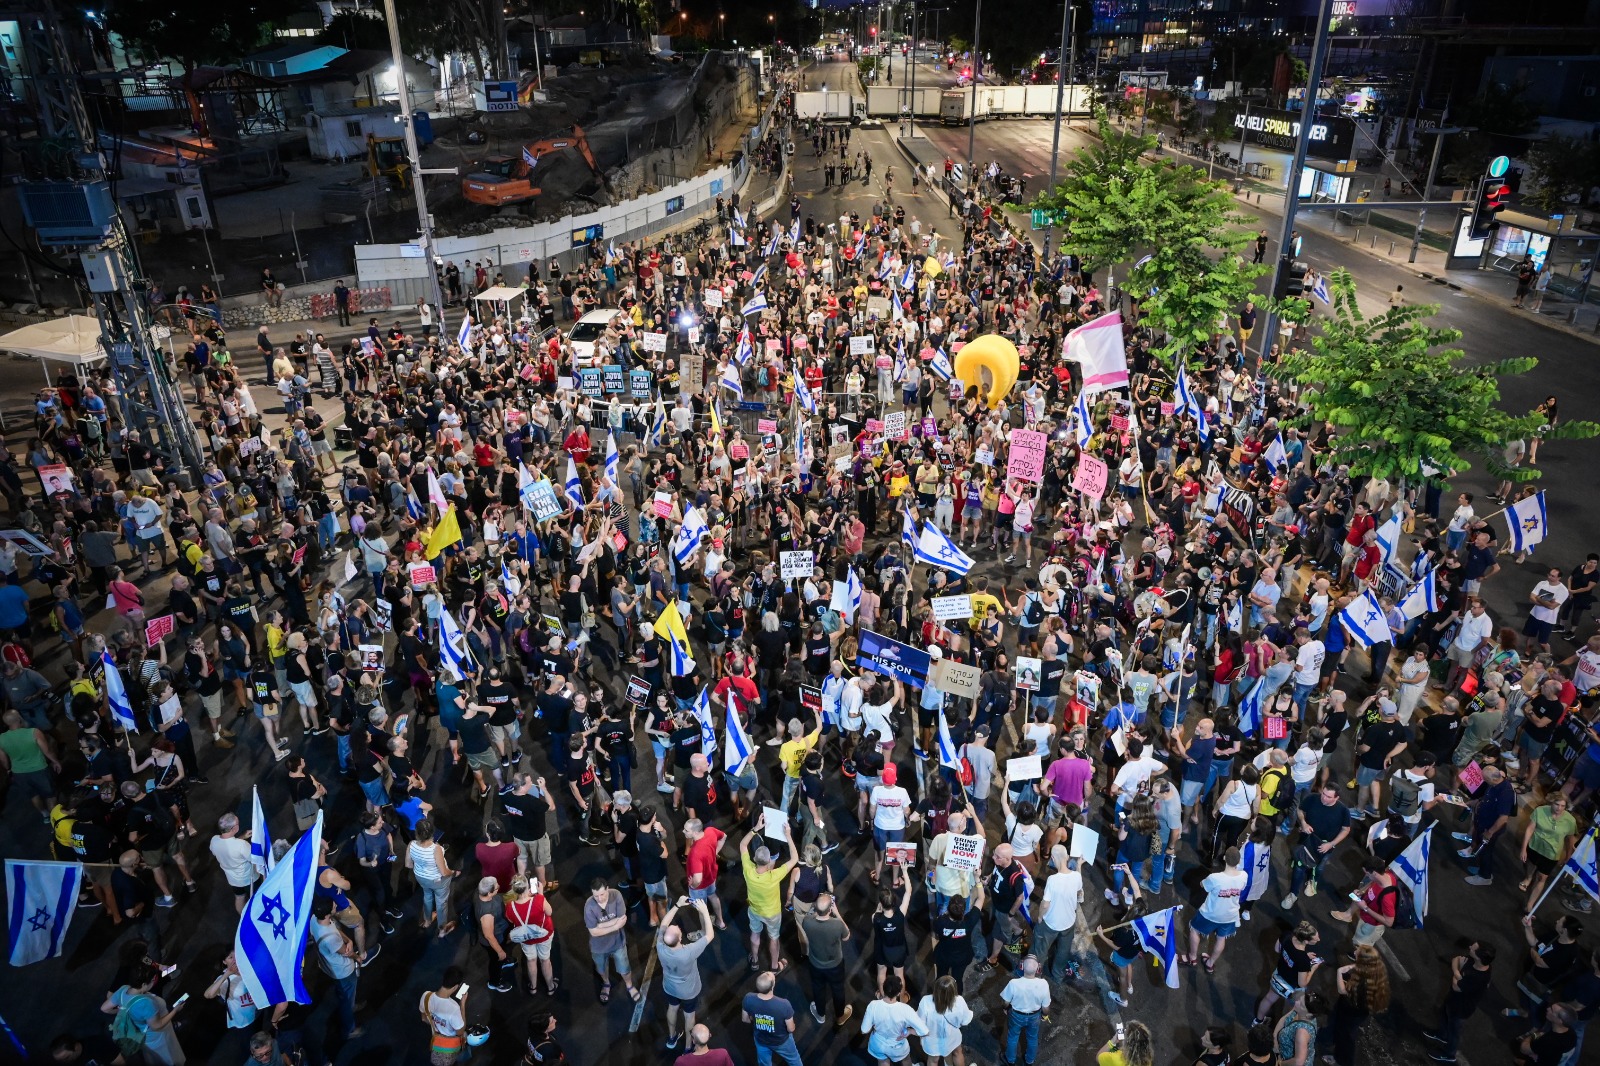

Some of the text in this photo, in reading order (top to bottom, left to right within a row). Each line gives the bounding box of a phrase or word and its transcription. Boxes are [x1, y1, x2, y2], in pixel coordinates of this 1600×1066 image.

[489, 101, 518, 111] הנדסה
[1264, 118, 1291, 136] SPIRAL
[528, 486, 550, 501] SEAL
[534, 495, 553, 509] THE
[536, 503, 560, 519] DEAL
[871, 654, 912, 676] HIS SON
[950, 668, 974, 679] עסקה
[946, 675, 973, 688] עכשיו
[953, 836, 978, 846] BRING
[954, 841, 976, 850] THEM
[952, 845, 974, 854] HOME
[952, 849, 977, 860] NOW!
